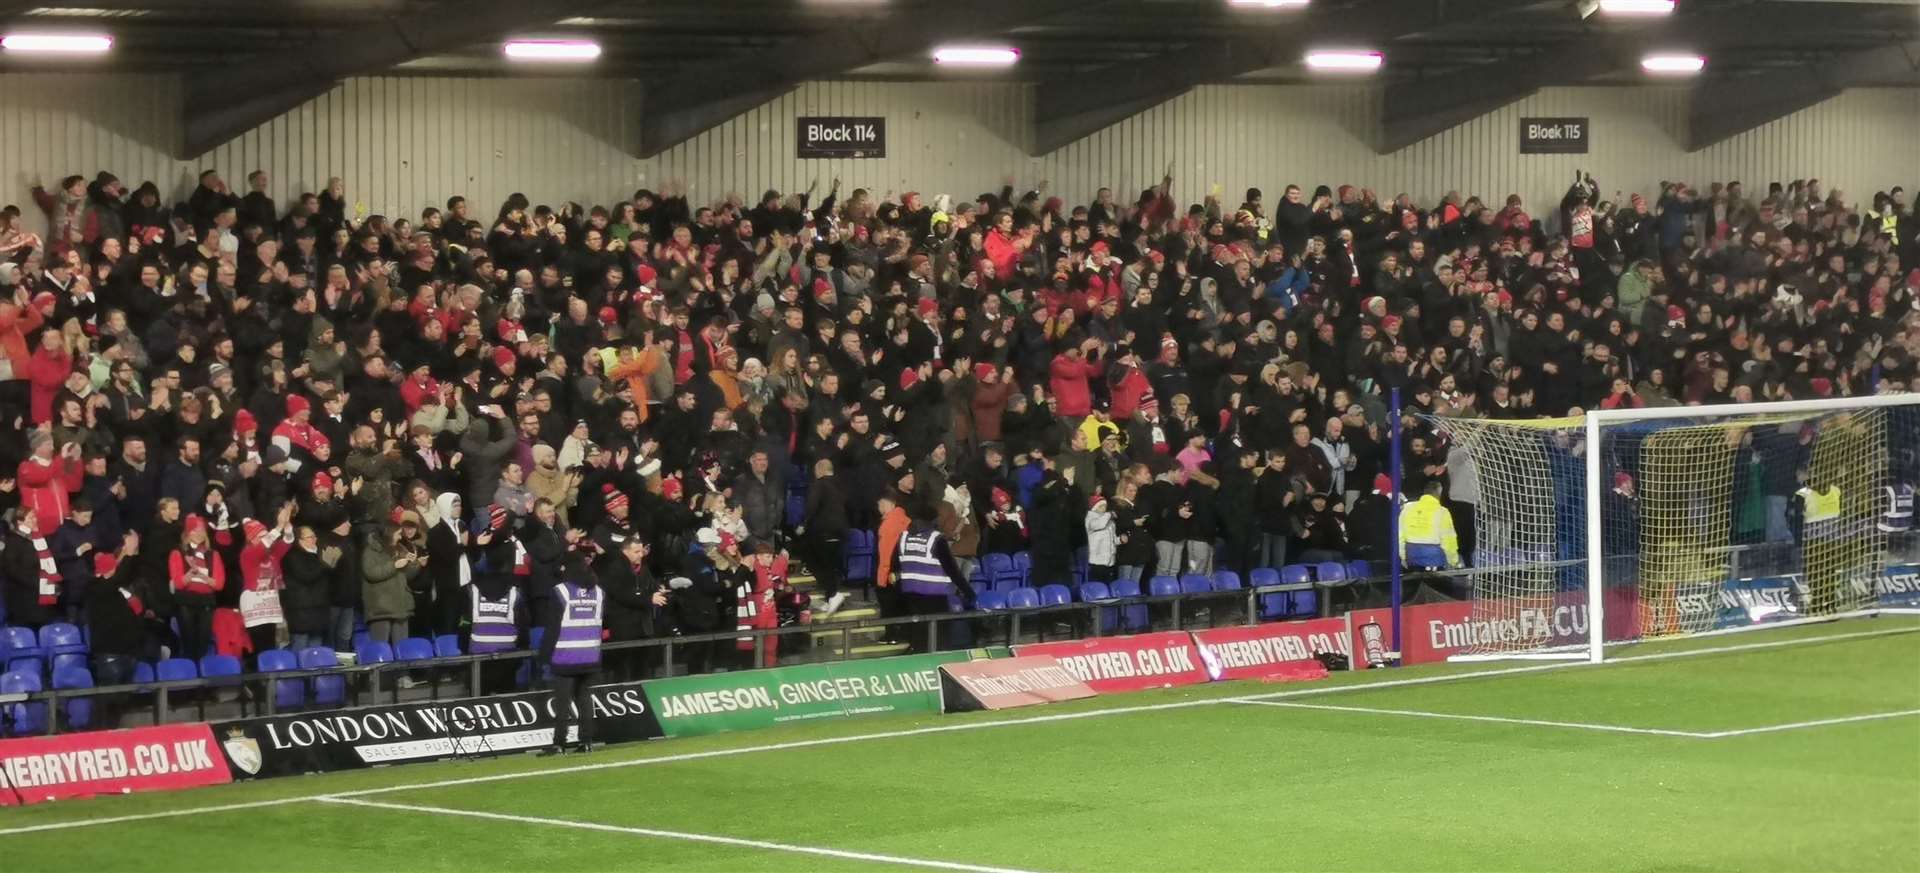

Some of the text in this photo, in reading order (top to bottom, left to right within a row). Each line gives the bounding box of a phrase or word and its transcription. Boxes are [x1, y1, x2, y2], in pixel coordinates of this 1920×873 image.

[808, 124, 876, 142] Block 114
[1528, 124, 1581, 140] Block 115
[1428, 604, 1596, 650] Emirates FA CU
[1056, 645, 1195, 681] RRYRED.CO.UK
[662, 687, 779, 718] JAMESON,
[780, 677, 870, 705] GINGER
[870, 675, 889, 697] &
[886, 670, 940, 695] LIME
[266, 711, 413, 750] LONDON
[416, 700, 538, 733] WORLD
[365, 743, 407, 759] SALES
